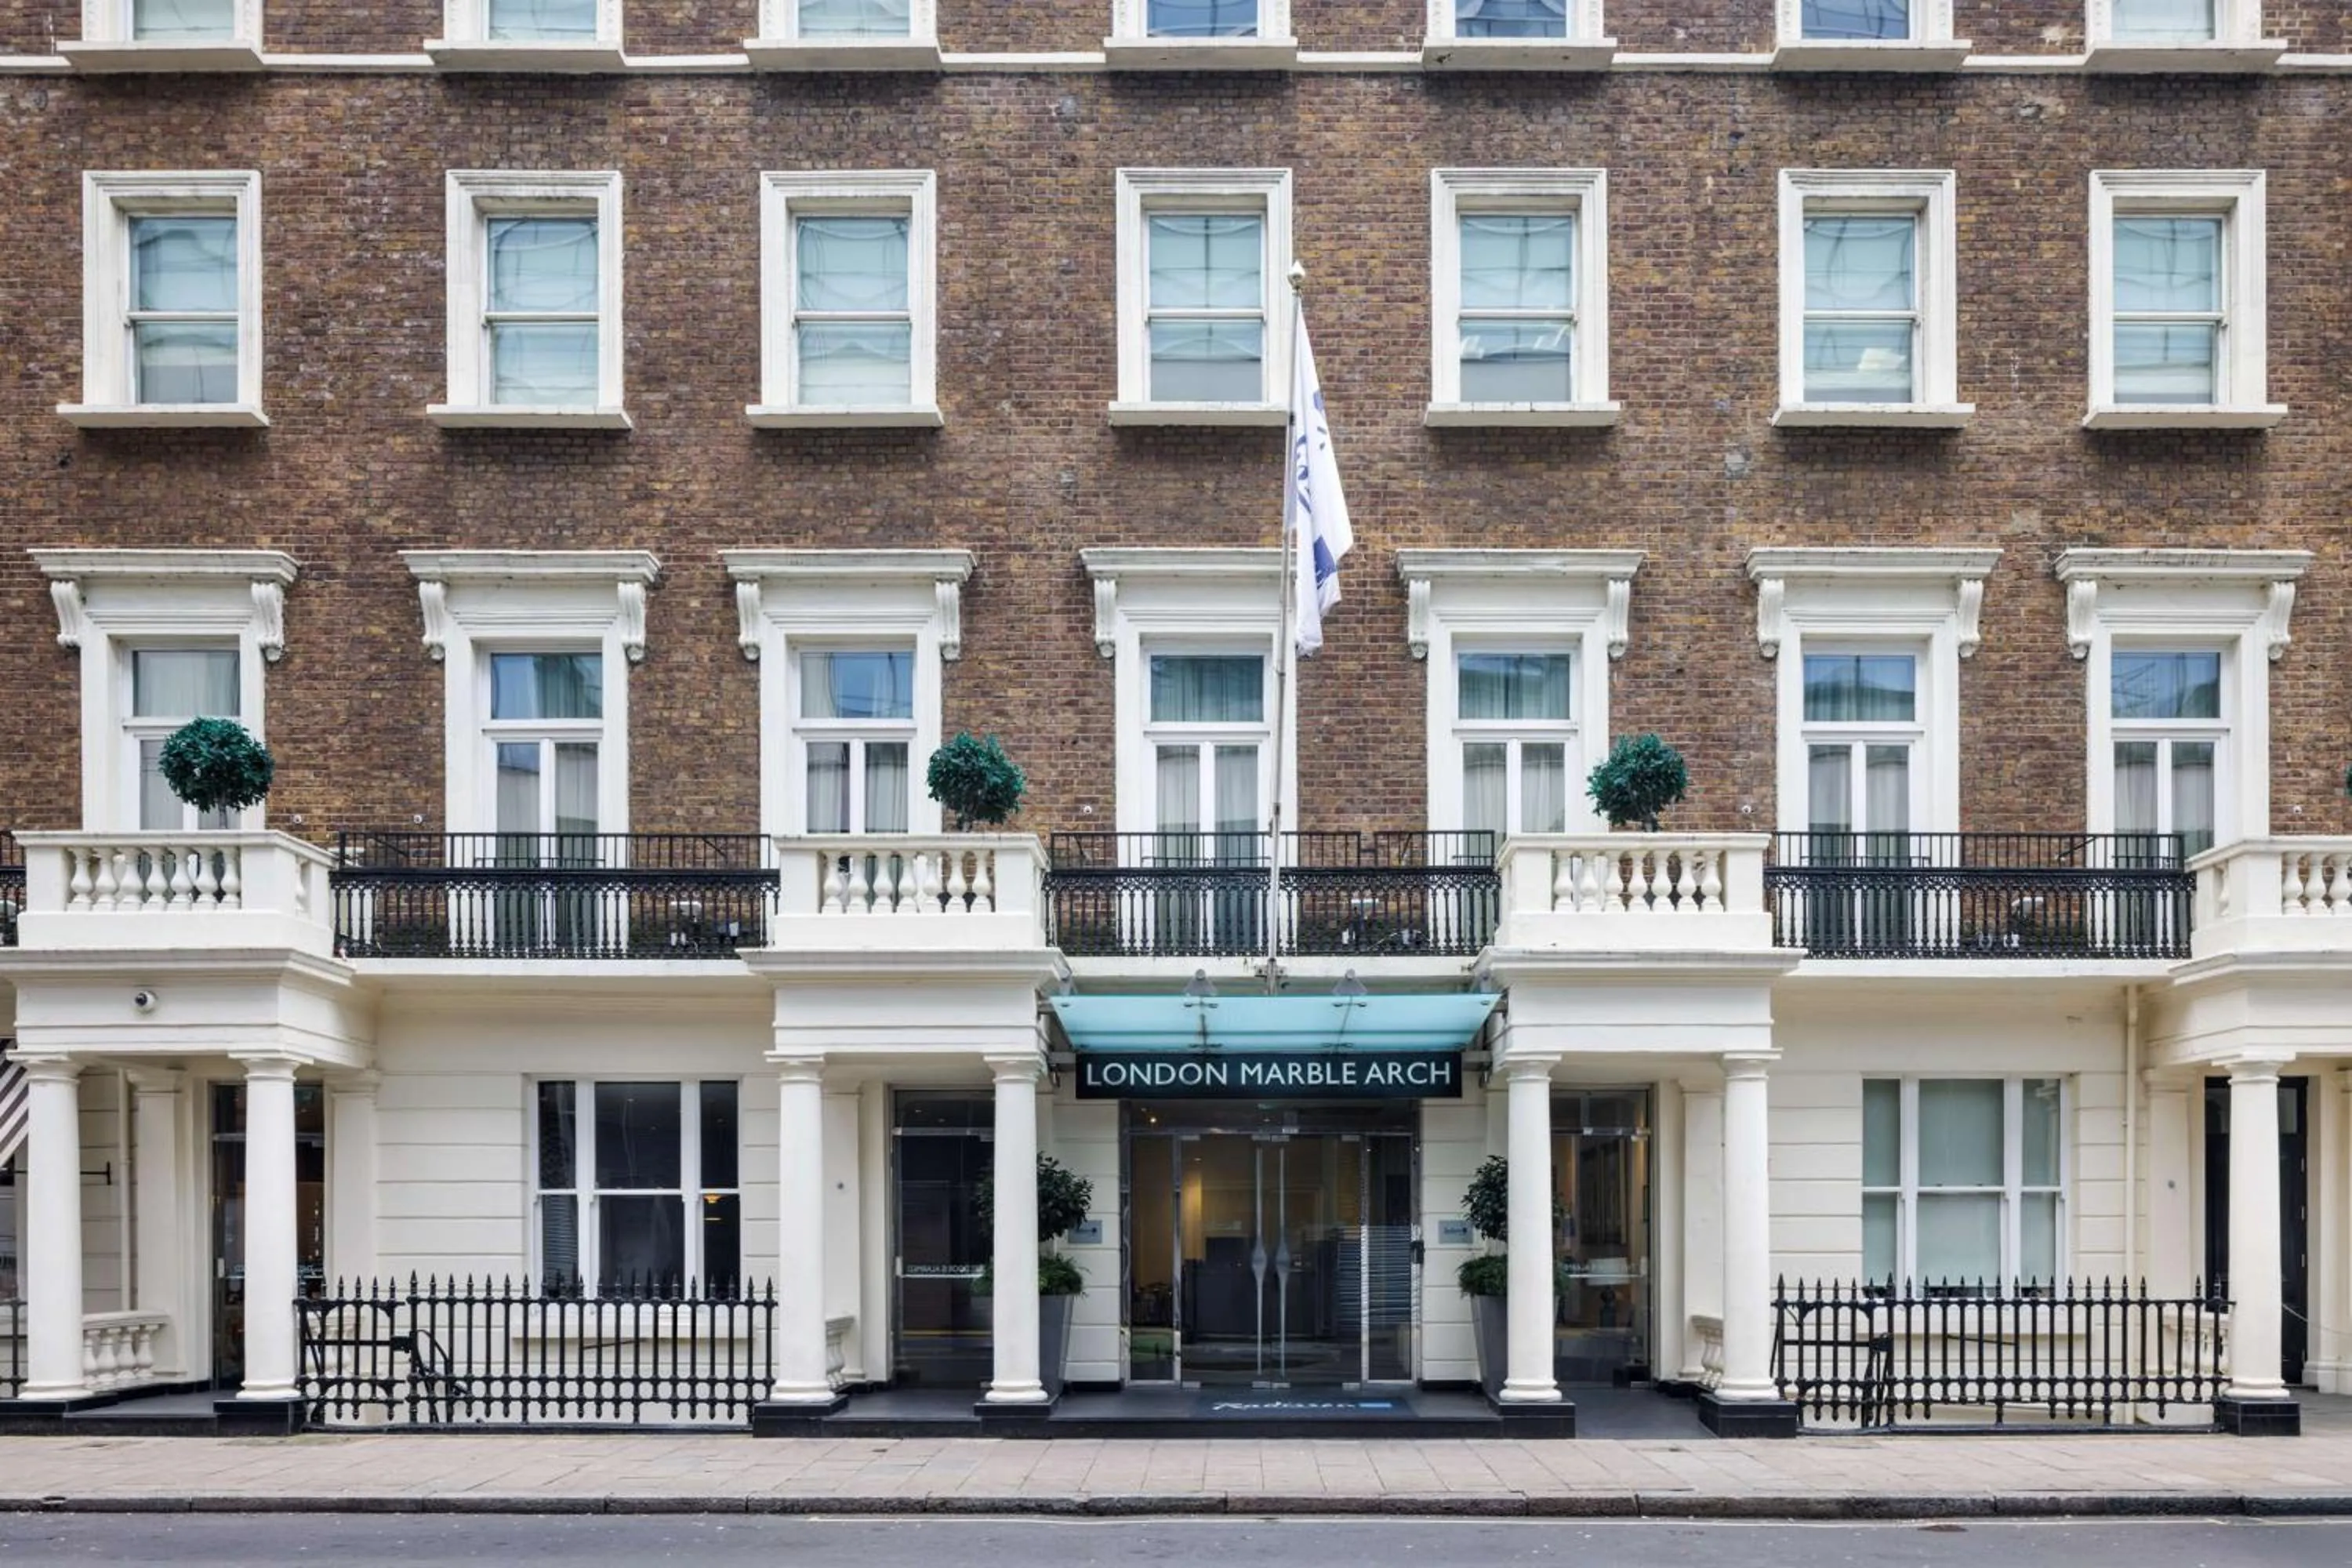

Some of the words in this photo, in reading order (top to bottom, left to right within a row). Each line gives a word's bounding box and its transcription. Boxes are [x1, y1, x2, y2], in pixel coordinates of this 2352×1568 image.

[1087, 1062, 1227, 1086] LONDON
[1240, 1062, 1356, 1085] MARBLE
[1364, 1061, 1450, 1085] ARCH
